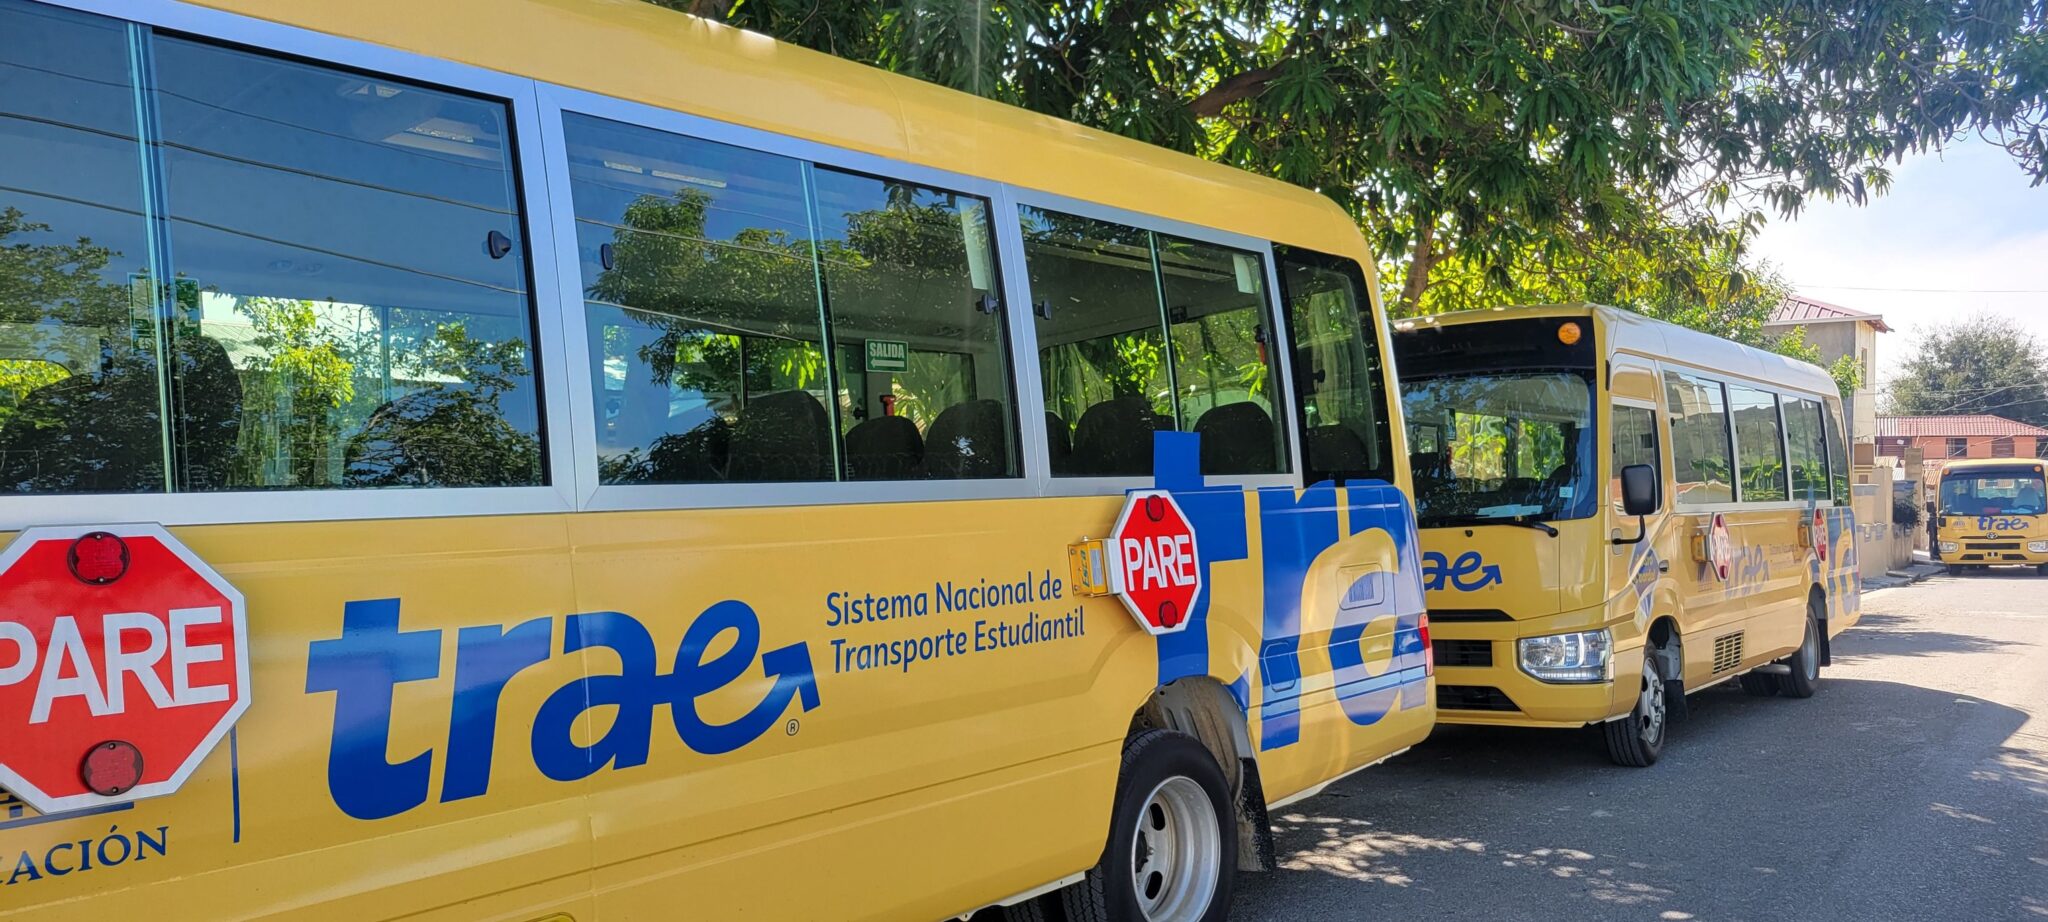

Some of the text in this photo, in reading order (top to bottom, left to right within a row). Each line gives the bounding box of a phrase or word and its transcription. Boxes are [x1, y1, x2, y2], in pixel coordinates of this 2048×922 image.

[869, 342, 905, 359] SALIDA
[1977, 515, 2029, 531] trae
[1123, 534, 1196, 592] PARE
[1423, 551, 1503, 592] ae
[826, 569, 1062, 627] Sistema Nacional de
[830, 605, 1085, 673] Transporte Estudiantil
[304, 597, 821, 821] trae
[0, 824, 169, 886] ACIÓN
